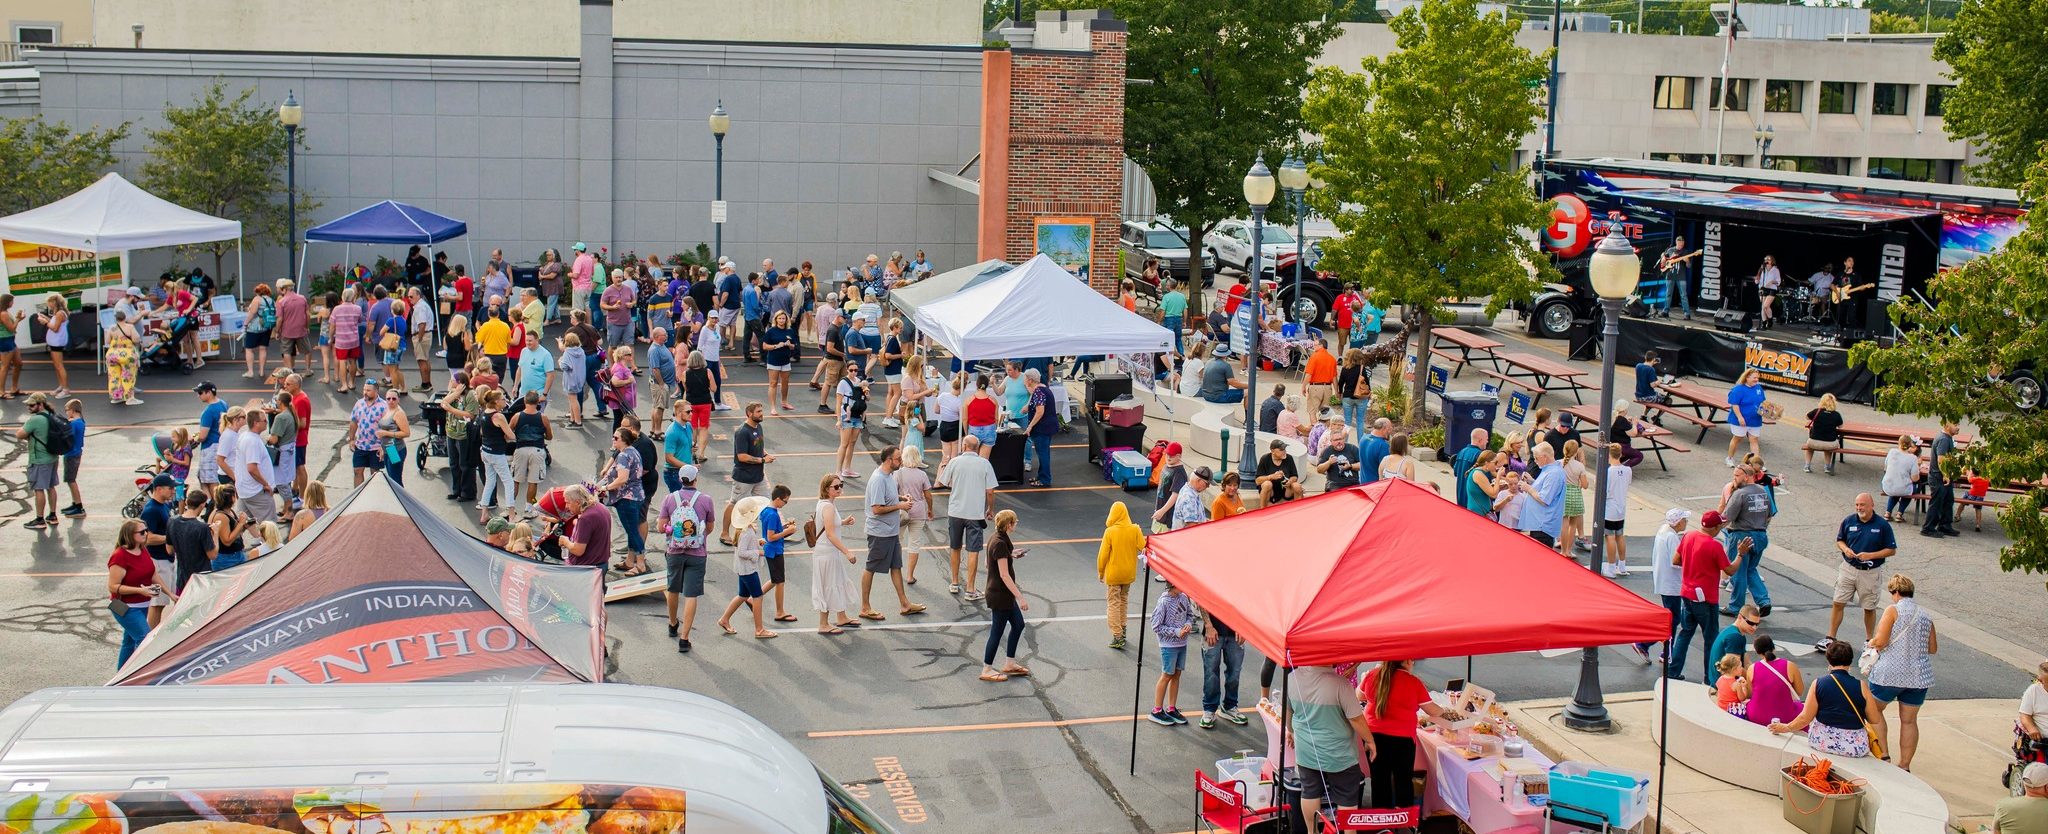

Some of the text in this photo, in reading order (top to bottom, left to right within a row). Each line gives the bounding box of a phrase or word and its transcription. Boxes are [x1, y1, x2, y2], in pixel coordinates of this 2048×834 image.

[1588, 219, 1643, 239] GRTE
[1700, 220, 1721, 301] GROUPIES
[1877, 243, 1905, 302] ANTED
[1745, 347, 1812, 375] WRSW
[174, 593, 473, 687] FORT WAYNE, INDIANA
[872, 756, 928, 823] RESERVED
[1351, 814, 1406, 823] GUIDESMAN
